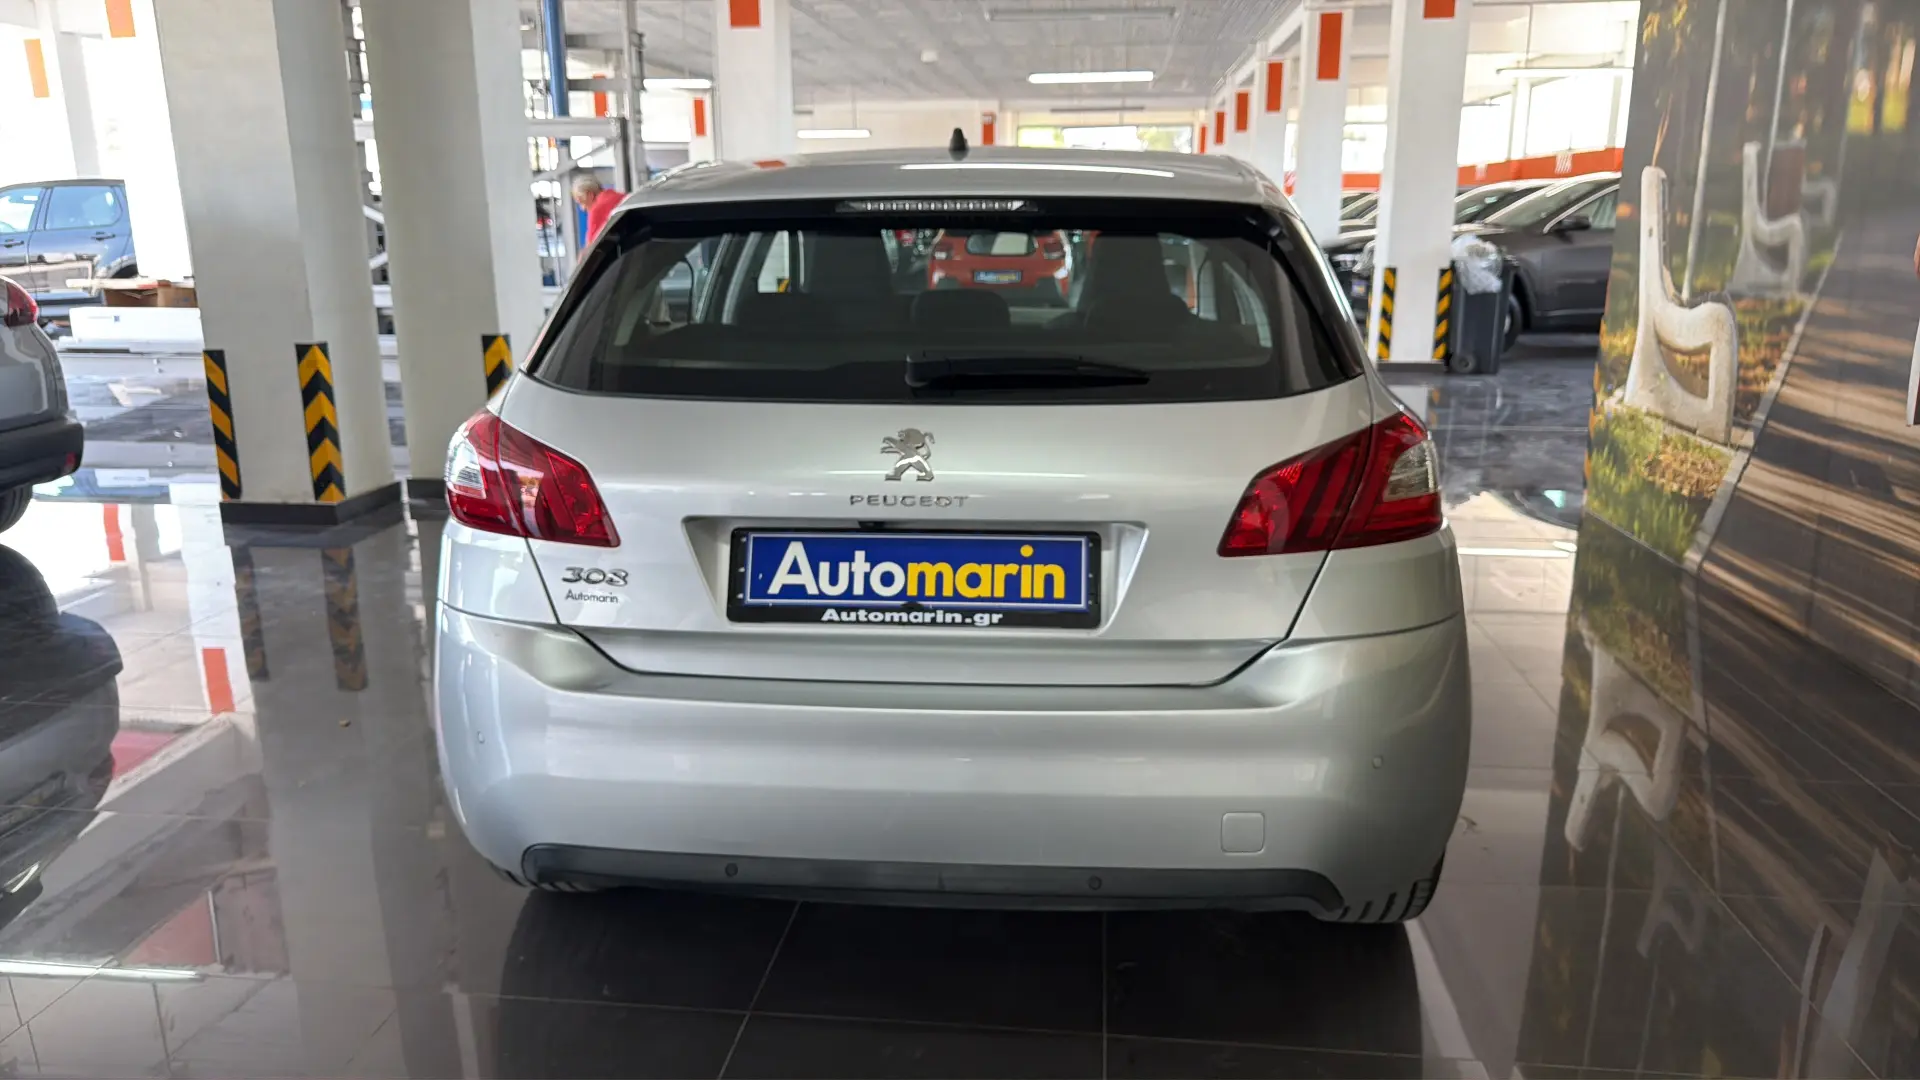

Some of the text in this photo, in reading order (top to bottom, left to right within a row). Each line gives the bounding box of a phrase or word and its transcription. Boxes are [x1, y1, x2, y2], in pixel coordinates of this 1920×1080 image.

[849, 495, 968, 507] PEUGEOT
[561, 567, 629, 587] 308
[767, 540, 1065, 599] Automarin
[564, 588, 619, 604] Automarin
[821, 608, 1003, 627] Automarin.gr
